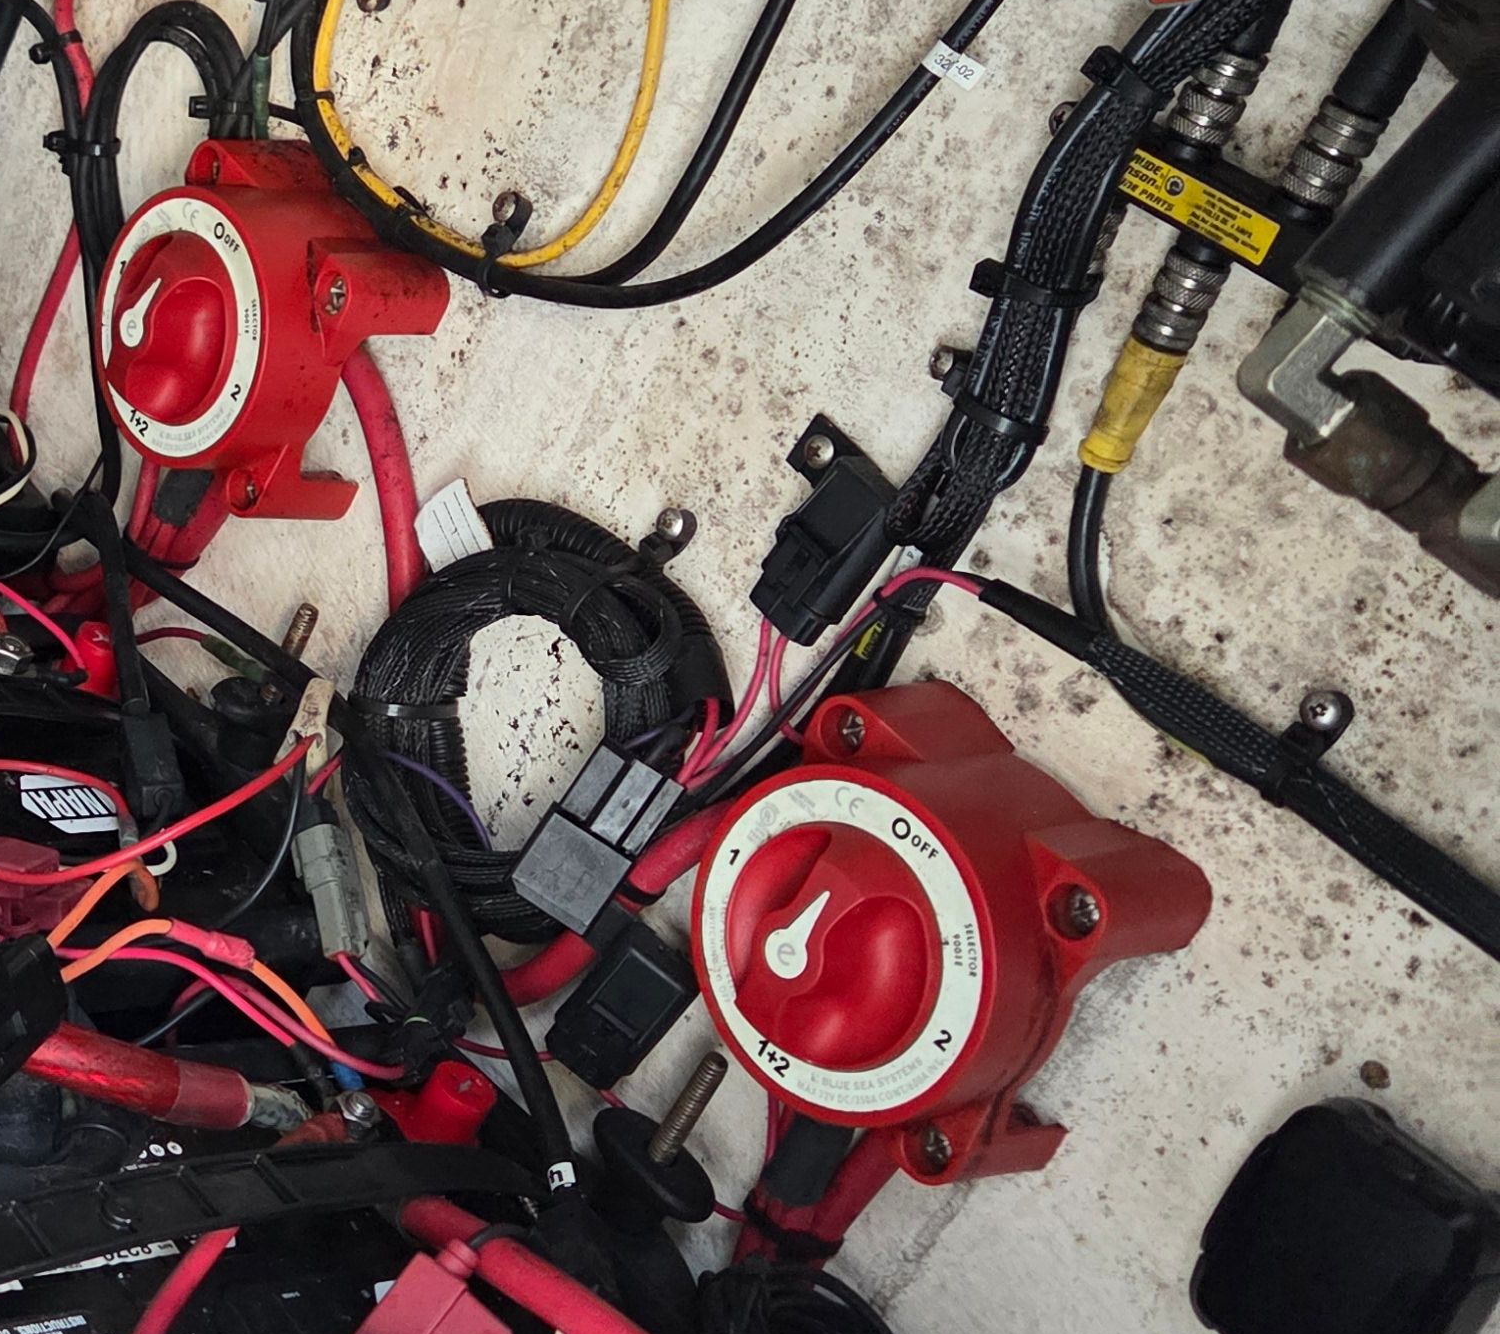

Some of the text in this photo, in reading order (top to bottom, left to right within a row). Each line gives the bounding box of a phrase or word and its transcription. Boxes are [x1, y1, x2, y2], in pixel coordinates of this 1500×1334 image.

[119, 260, 127, 275] 1
[230, 384, 241, 402] 2
[129, 409, 149, 437] 1+2
[25, 786, 108, 819] NAPA
[727, 848, 740, 865] 1
[911, 834, 940, 860] OFF
[964, 922, 977, 978] SELECTOR
[933, 1029, 952, 1052] 2
[757, 1039, 790, 1078] 1+2
[853, 1076, 875, 1090] SEA
[877, 1056, 924, 1089] SYSTEMS
